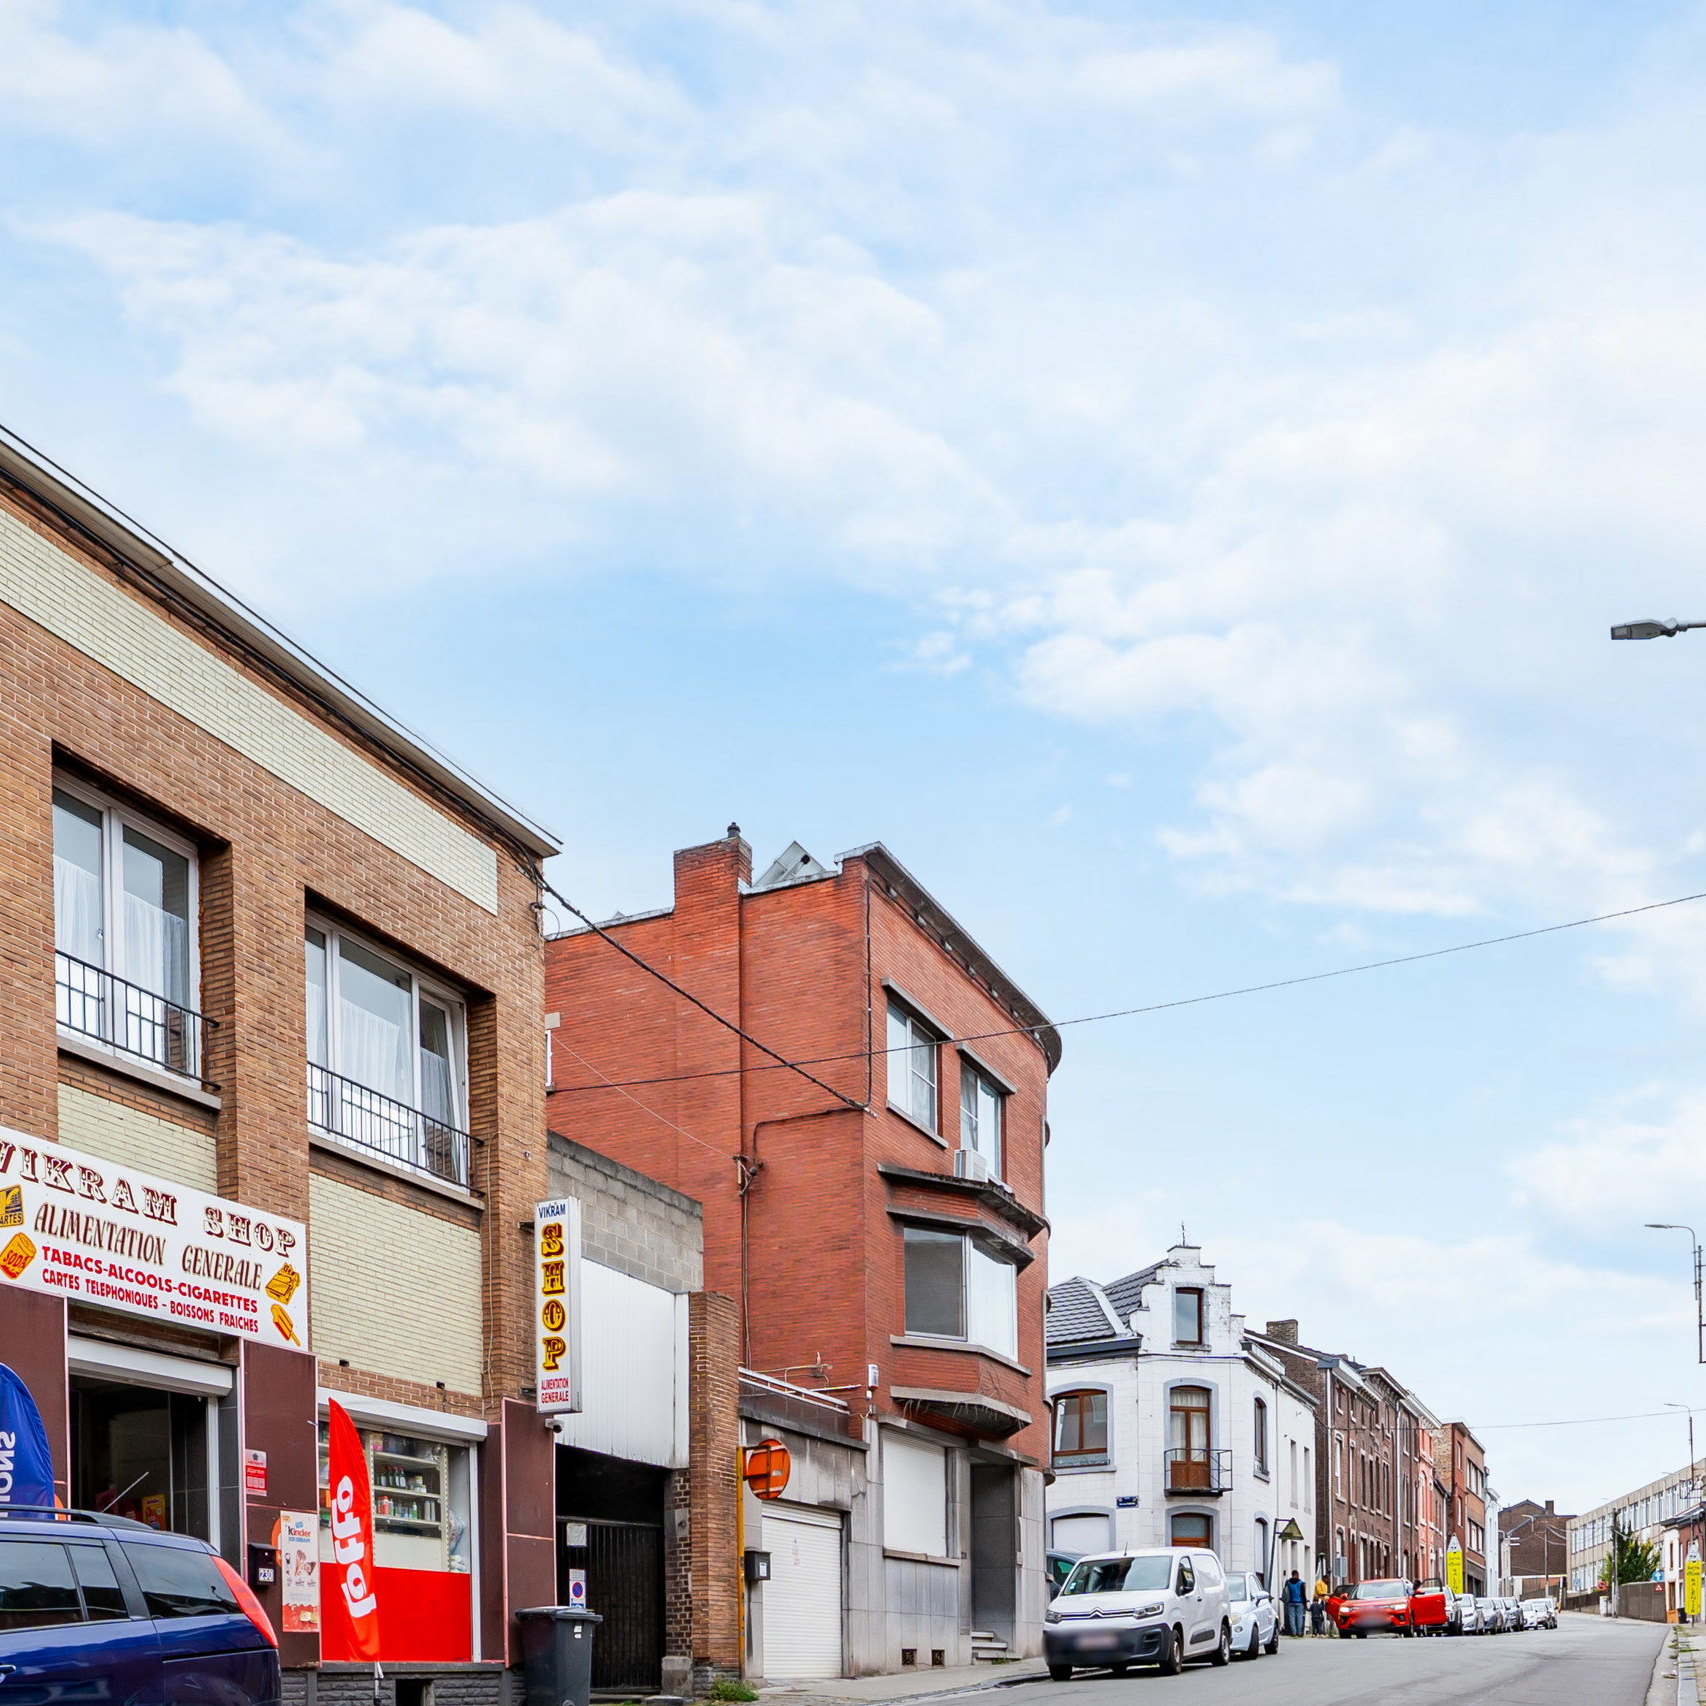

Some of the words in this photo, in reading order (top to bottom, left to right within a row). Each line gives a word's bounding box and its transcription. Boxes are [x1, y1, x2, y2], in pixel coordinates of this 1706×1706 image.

[204, 1206, 296, 1259] SHOP
[538, 1203, 566, 1219] VIKRAM
[2, 1249, 29, 1270] SODA
[33, 1201, 167, 1267] ALIMENTATION
[181, 1244, 263, 1291] GENERALE
[41, 1245, 258, 1314] TABACS-ALCOOLS-CIGARETTES
[42, 1268, 80, 1291] CARTES
[85, 1278, 159, 1310] TELEPHONIQUES
[170, 1300, 215, 1323] BOISSONS
[219, 1311, 259, 1333] FRAICHES
[541, 1222, 567, 1372] SHOP
[541, 1390, 569, 1404] GENERALE
